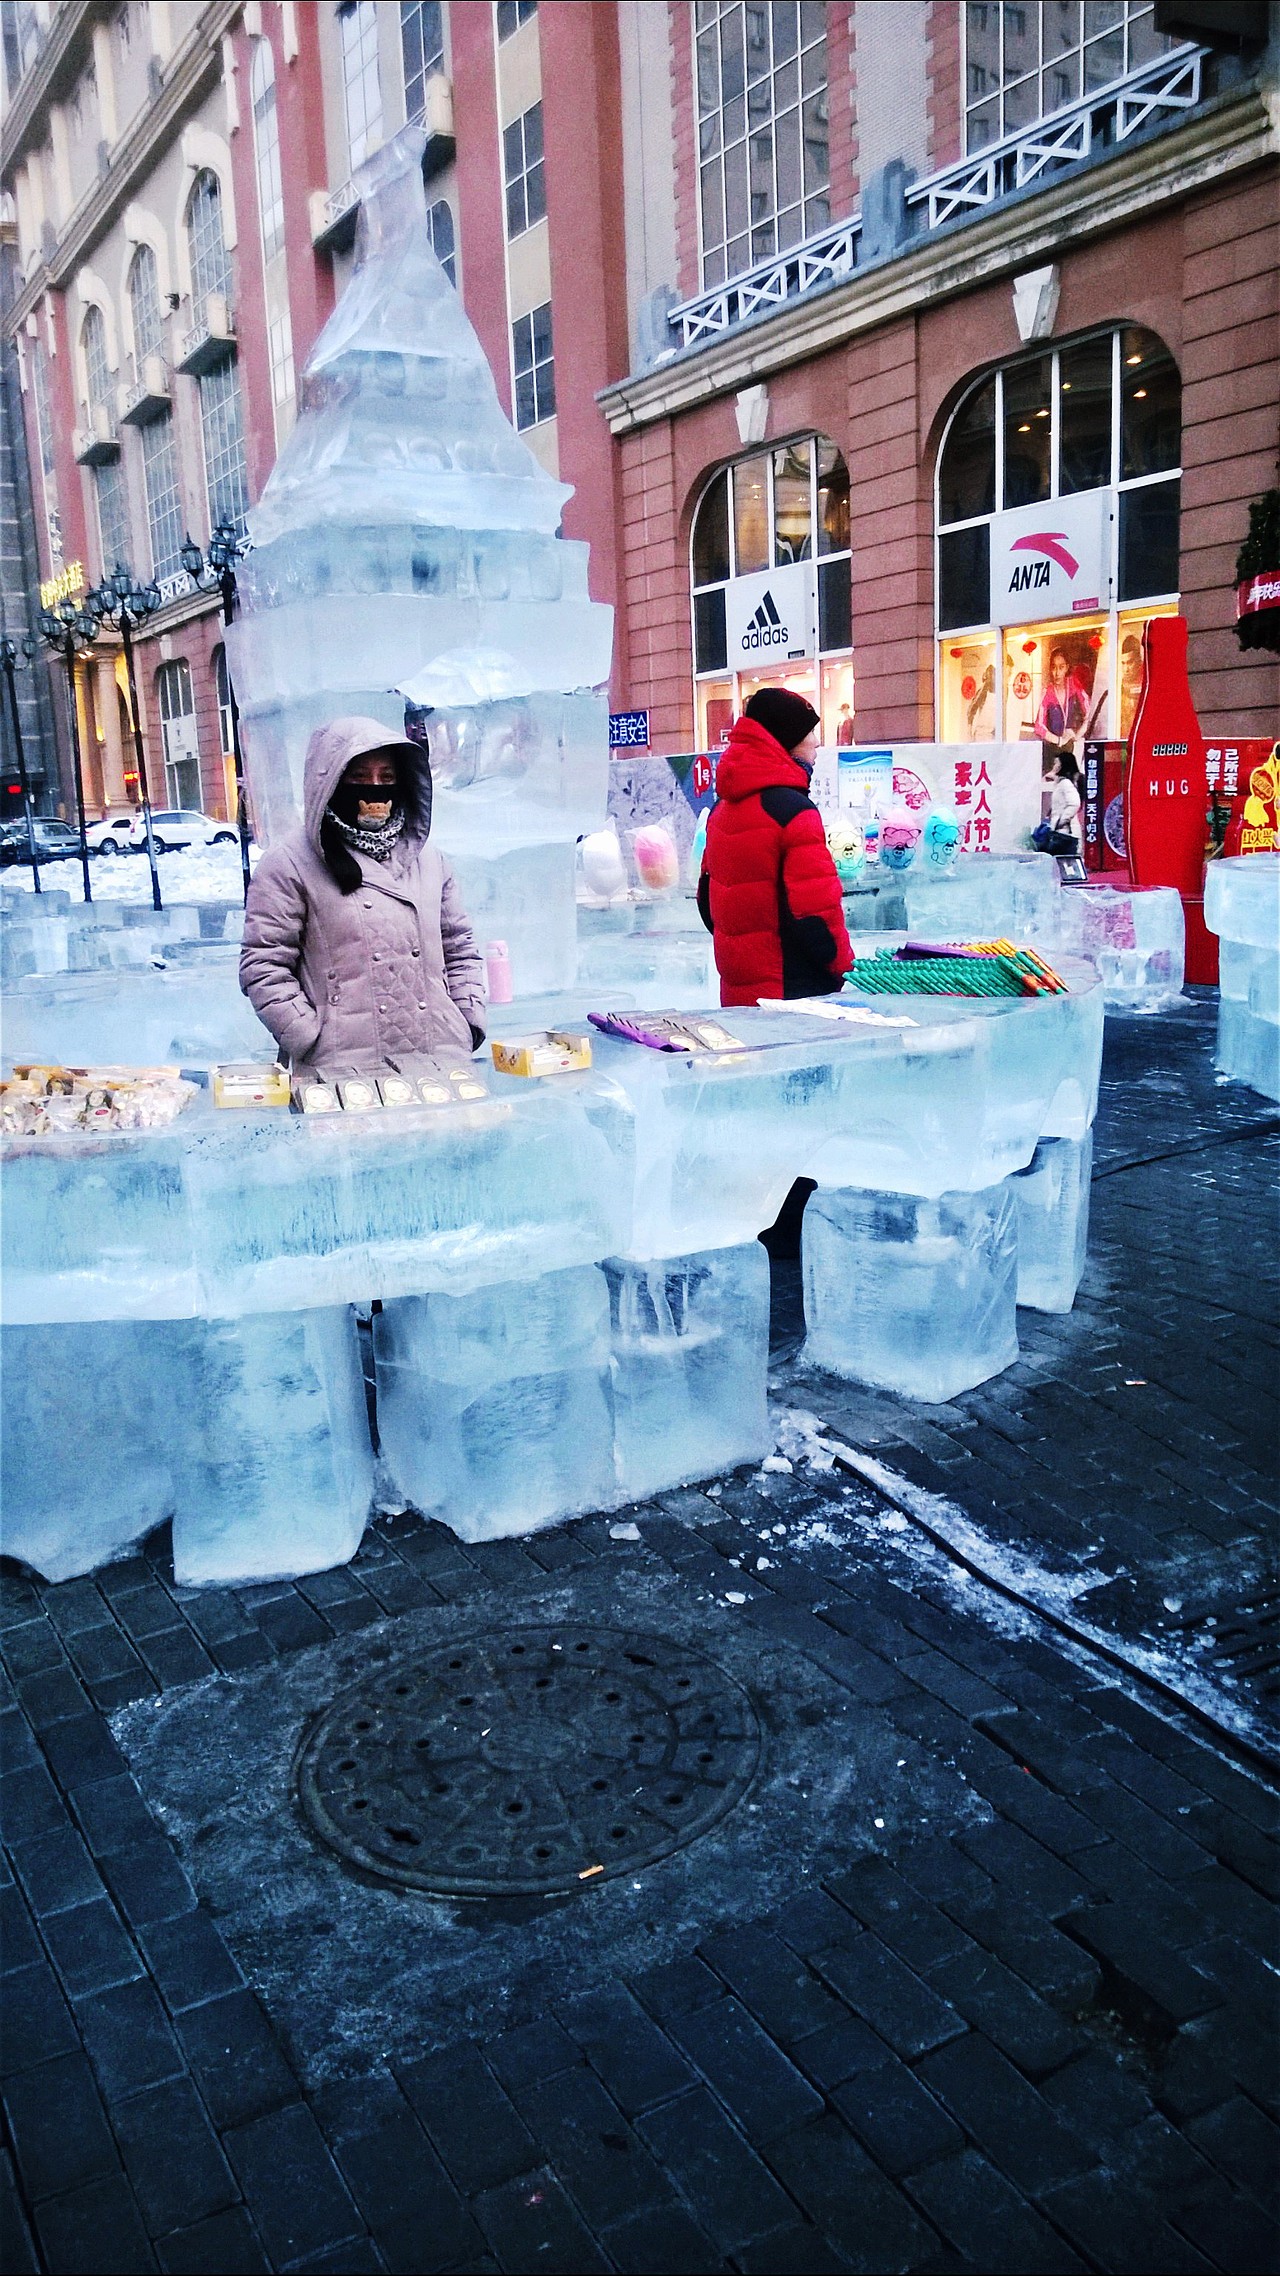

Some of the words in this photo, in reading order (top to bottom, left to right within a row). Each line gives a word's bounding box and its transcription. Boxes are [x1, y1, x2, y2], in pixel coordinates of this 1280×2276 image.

[1008, 560, 1051, 593] ANTA
[742, 625, 789, 650] adidas
[609, 714, 647, 744] 注意安全
[694, 759, 711, 787] 1号
[1149, 779, 1189, 796] HUG
